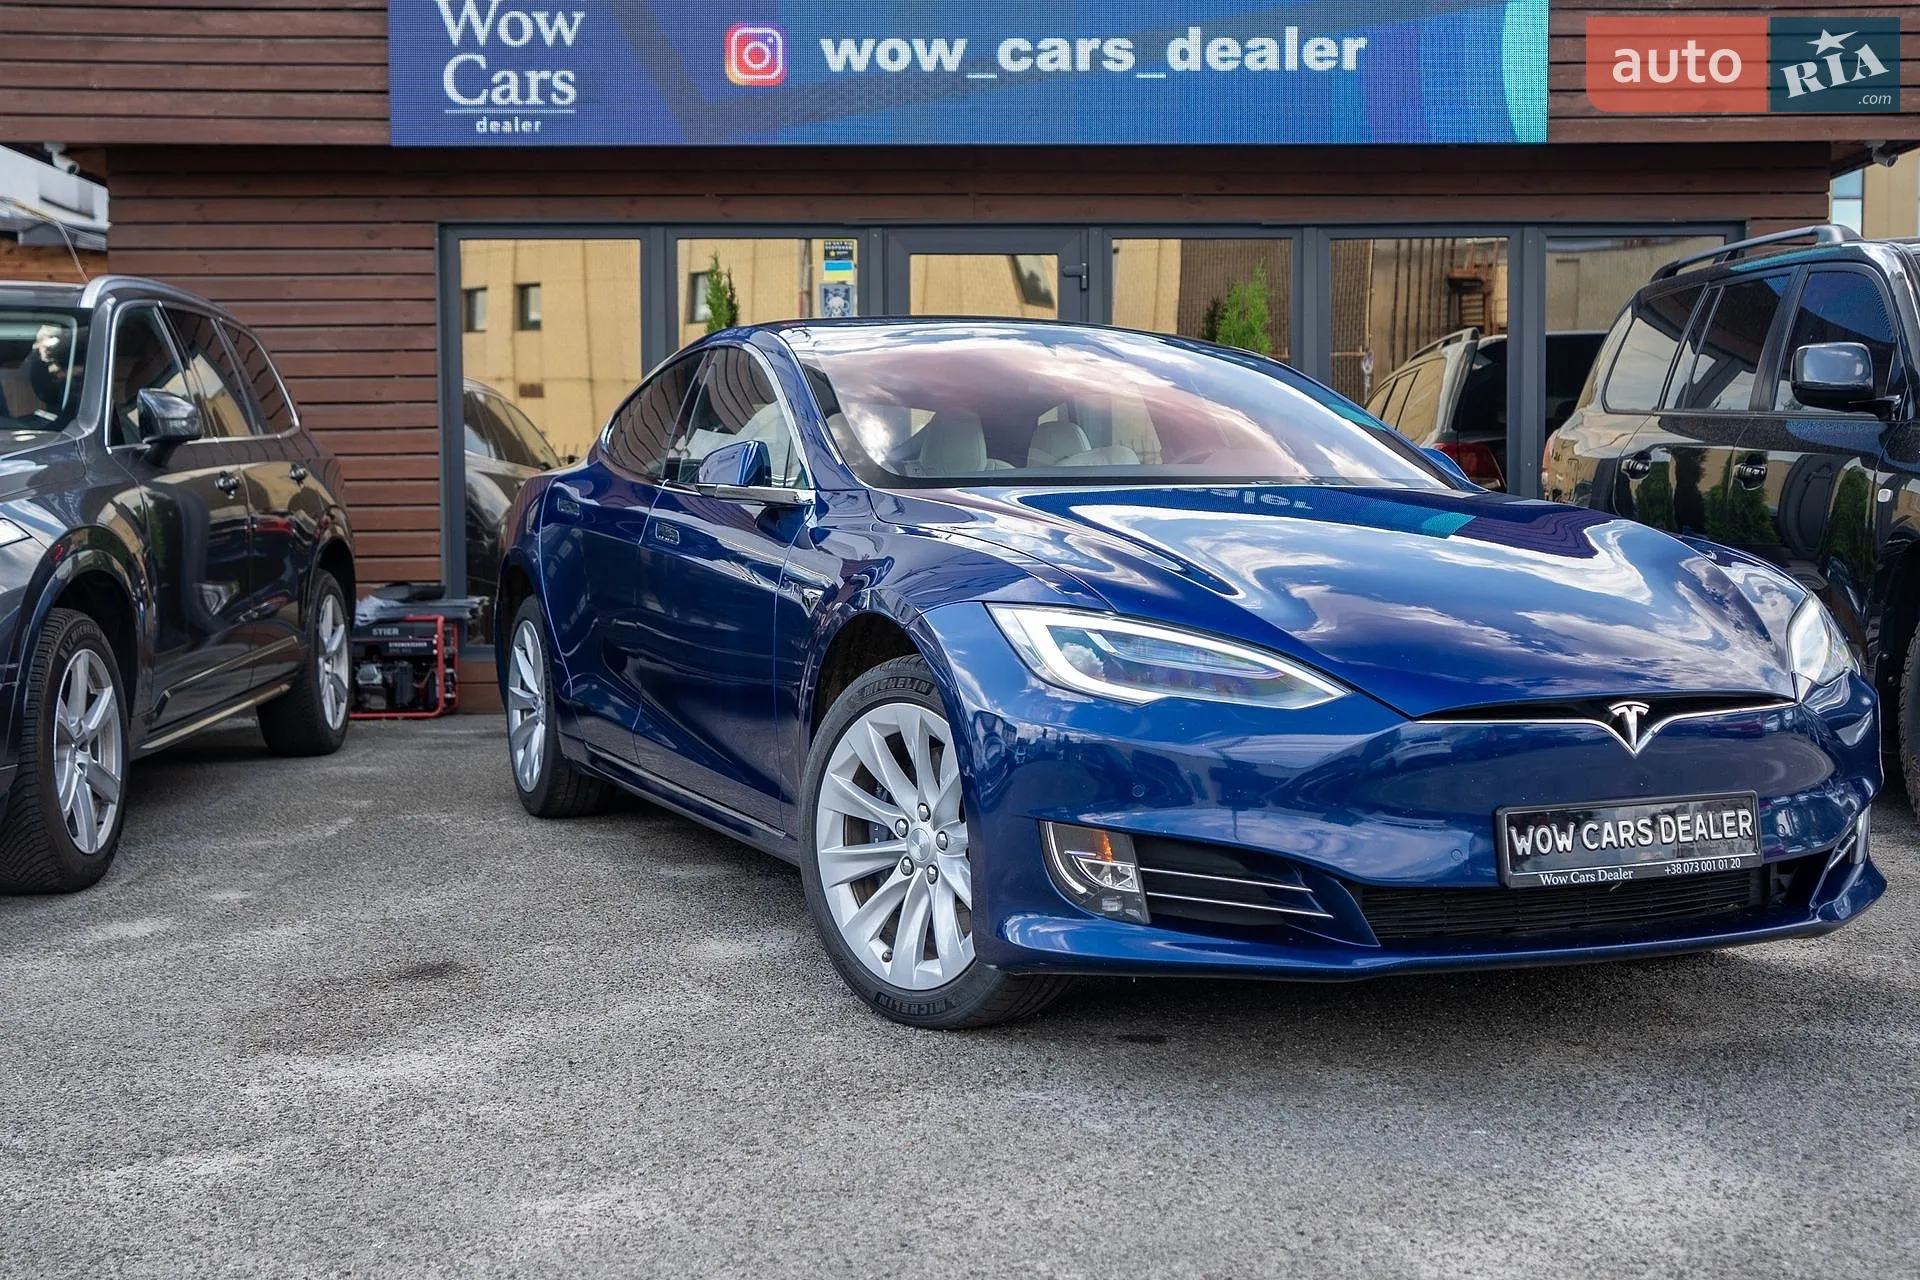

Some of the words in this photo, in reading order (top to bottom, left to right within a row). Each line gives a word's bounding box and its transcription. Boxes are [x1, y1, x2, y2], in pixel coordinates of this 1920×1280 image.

[436, 0, 585, 47] Wow
[820, 26, 1367, 78] wow_cars_dealer
[443, 53, 578, 106] Cars
[475, 116, 542, 133] dealer
[372, 628, 399, 636] STIER
[864, 677, 931, 697] MICHELIN
[1509, 822, 1575, 857] WOW
[1582, 818, 1654, 851] CARS
[1659, 808, 1753, 844] DEALER
[1539, 873, 1569, 886] Wow
[1571, 872, 1597, 884] Cars
[1598, 869, 1634, 881] Dealer
[1664, 865, 1682, 875] +38
[1683, 863, 1699, 873] 073
[1701, 861, 1716, 872] 001
[1718, 860, 1728, 870] 01
[1730, 858, 1741, 869] 20
[878, 993, 946, 1015] MICHELIN
